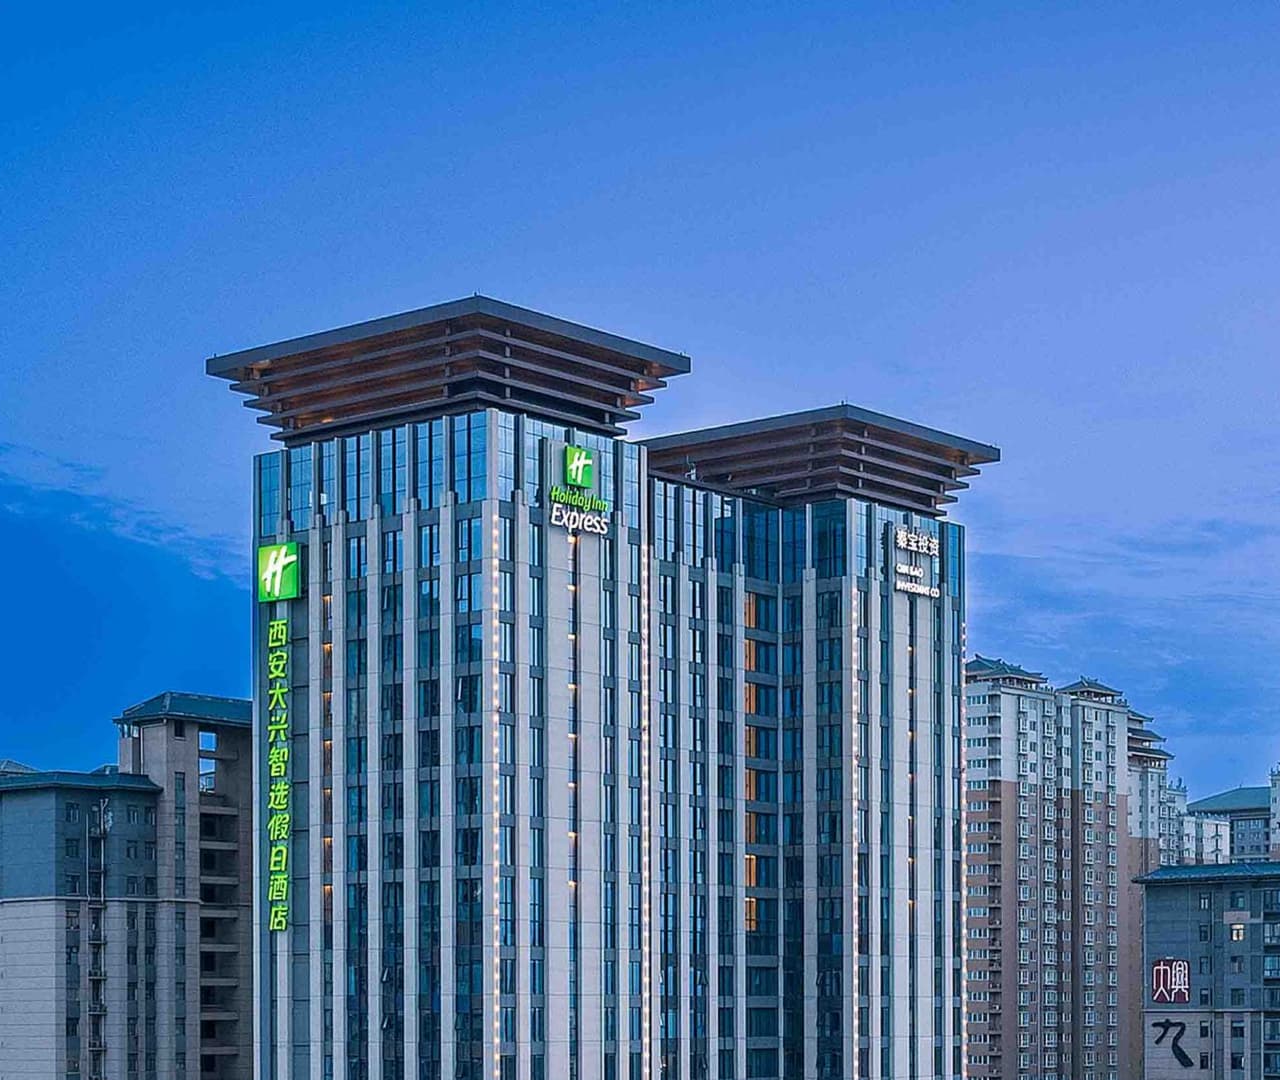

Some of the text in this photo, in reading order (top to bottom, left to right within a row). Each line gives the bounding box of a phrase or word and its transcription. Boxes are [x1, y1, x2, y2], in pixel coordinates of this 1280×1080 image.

[551, 503, 610, 534] Express
[267, 619, 289, 932] 西安大兴智选假日酒店
